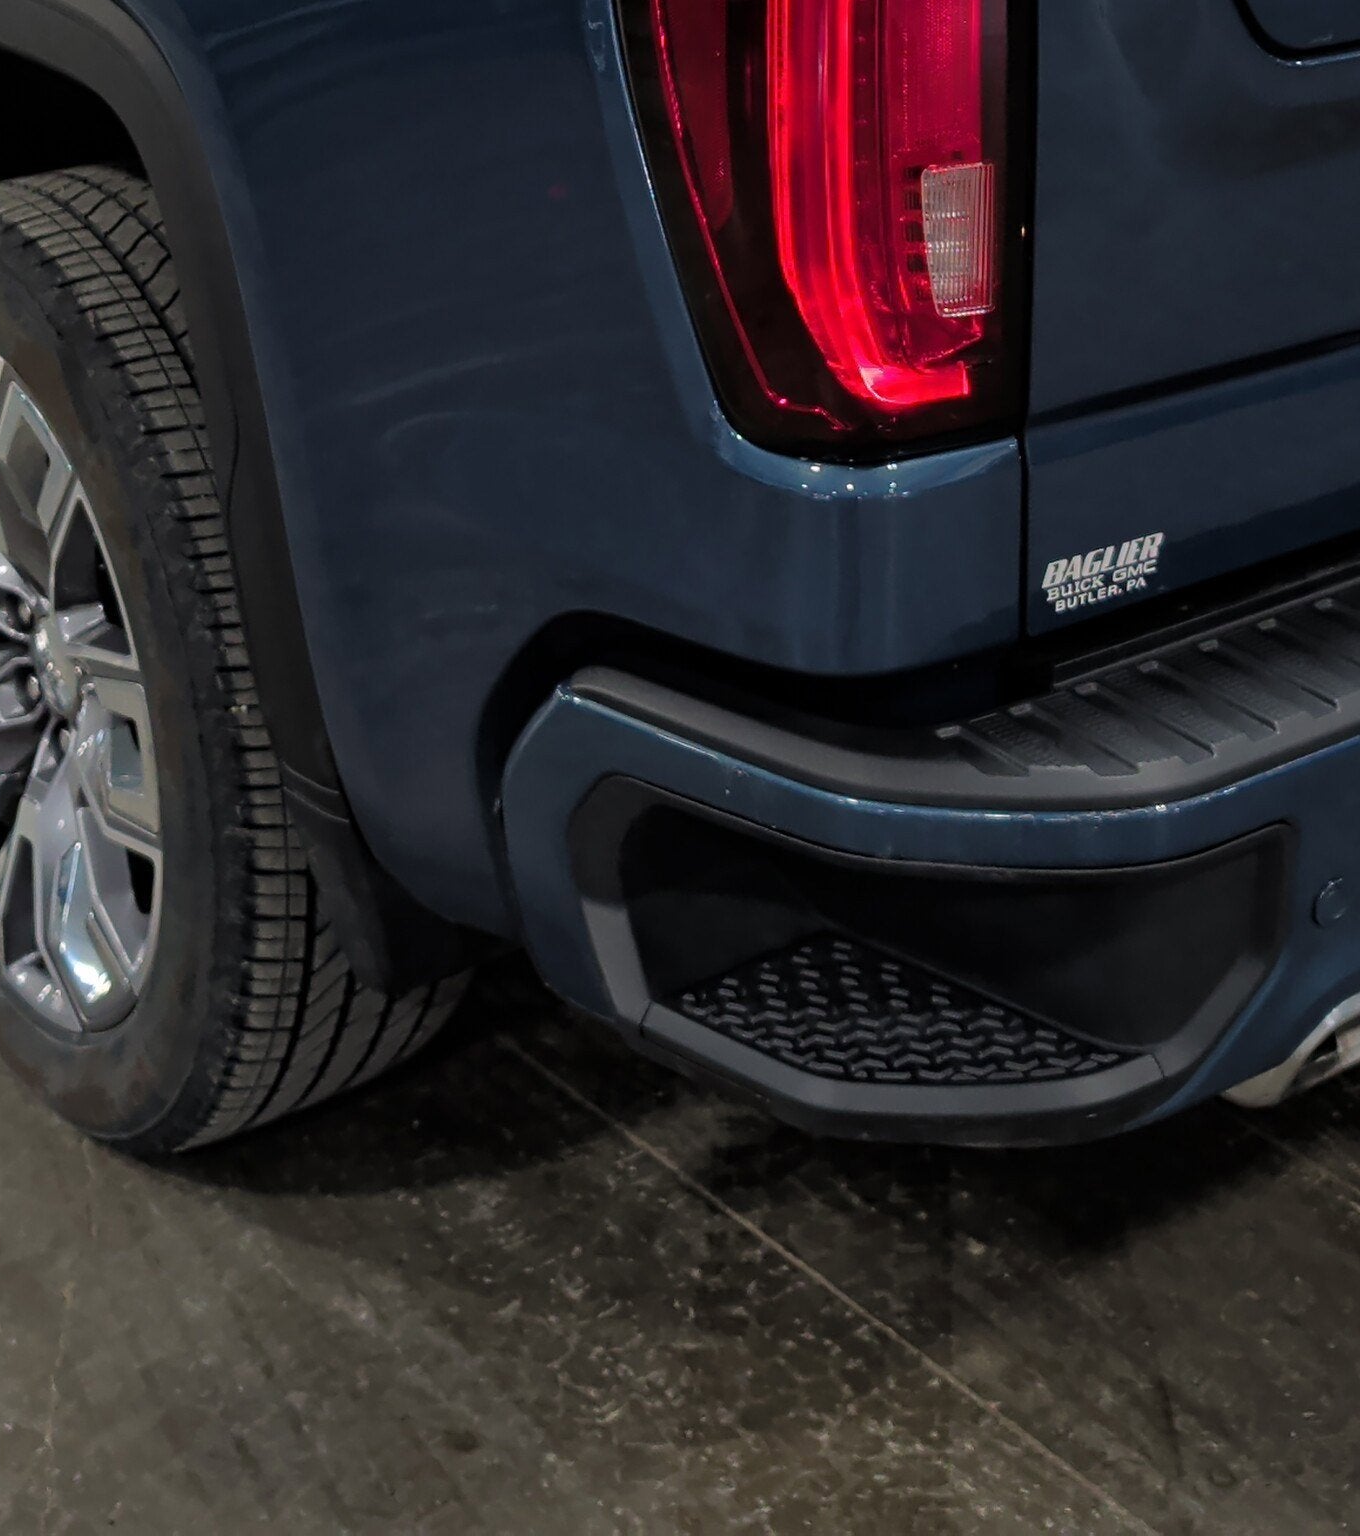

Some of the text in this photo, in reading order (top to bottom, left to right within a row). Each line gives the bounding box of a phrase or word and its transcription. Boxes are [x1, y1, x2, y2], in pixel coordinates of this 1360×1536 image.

[1041, 531, 1164, 588] BAGLIER
[1046, 558, 1158, 602] BUICK GMC
[1126, 575, 1147, 592] PA
